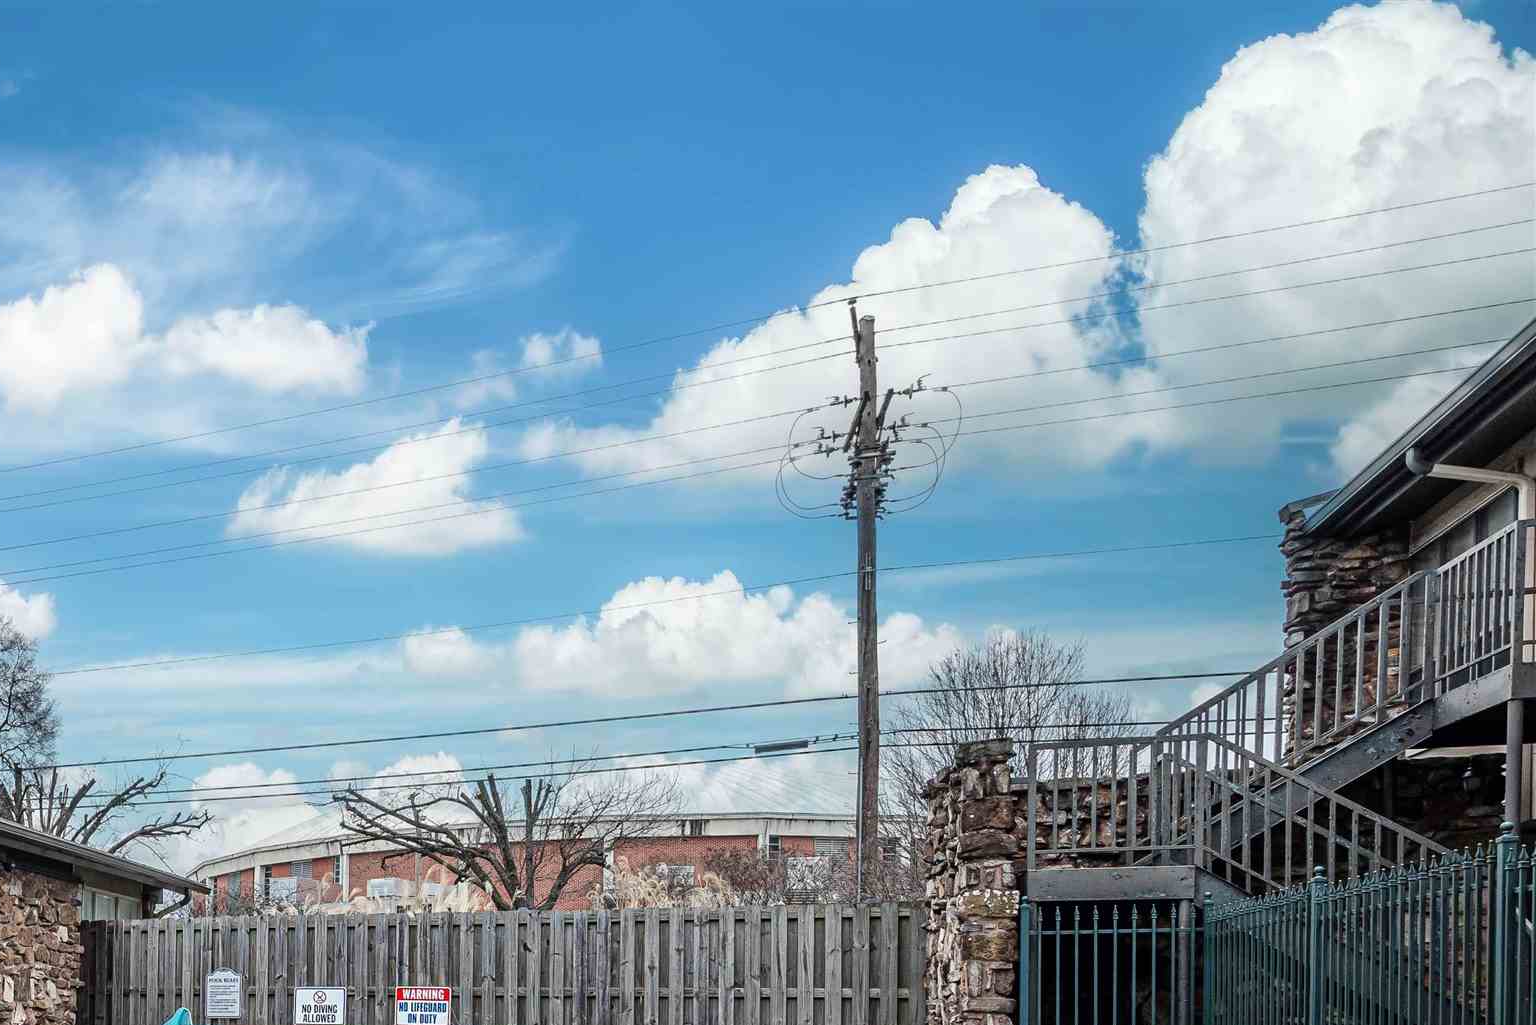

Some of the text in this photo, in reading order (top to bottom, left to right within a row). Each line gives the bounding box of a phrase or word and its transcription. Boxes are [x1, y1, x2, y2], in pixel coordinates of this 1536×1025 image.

[402, 989, 444, 1000] WARNING
[301, 1004, 338, 1014] NO DIVING
[399, 1001, 447, 1013] NO LIFEGUARD
[302, 1014, 336, 1023] ALLOWED
[407, 1013, 437, 1024] ON DUTY
